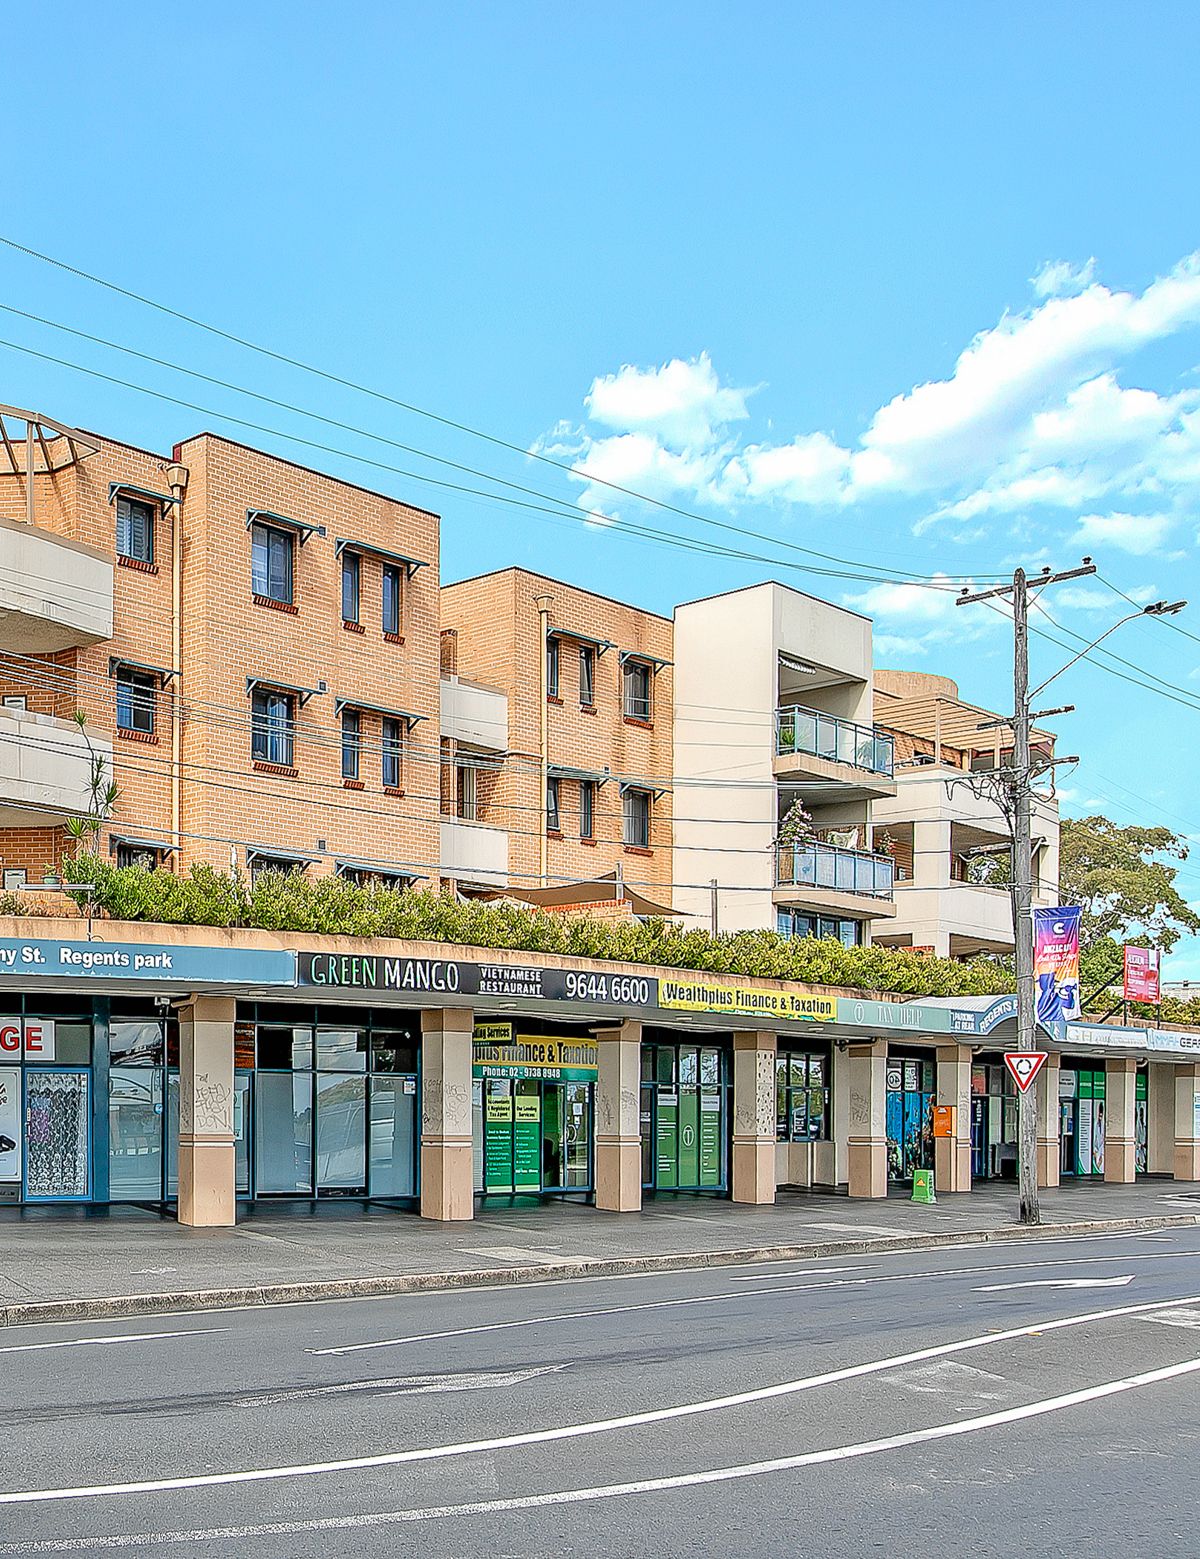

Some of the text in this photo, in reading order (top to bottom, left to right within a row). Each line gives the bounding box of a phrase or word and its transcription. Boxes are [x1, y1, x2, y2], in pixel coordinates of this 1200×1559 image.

[21, 946, 46, 963] St.
[59, 947, 129, 970] Regents
[134, 949, 173, 971] park
[311, 955, 459, 992] GREEN MANGO
[481, 967, 541, 983] VIETNAMESE
[479, 981, 542, 995] RESTAURANT
[566, 972, 649, 1004] 9644 6600
[666, 982, 832, 1014] Wealthplus Finance & Taxation
[877, 1005, 924, 1026] TAX HELP
[955, 1013, 975, 1022] PARKING
[980, 1001, 1012, 1032] REGENTS
[962, 1022, 975, 1031] REAR
[502, 1043, 545, 1062] Finance
[482, 1066, 508, 1076] Phone:
[509, 1067, 518, 1077] 02
[524, 1068, 541, 1077] 9738
[543, 1068, 560, 1078] 8948
